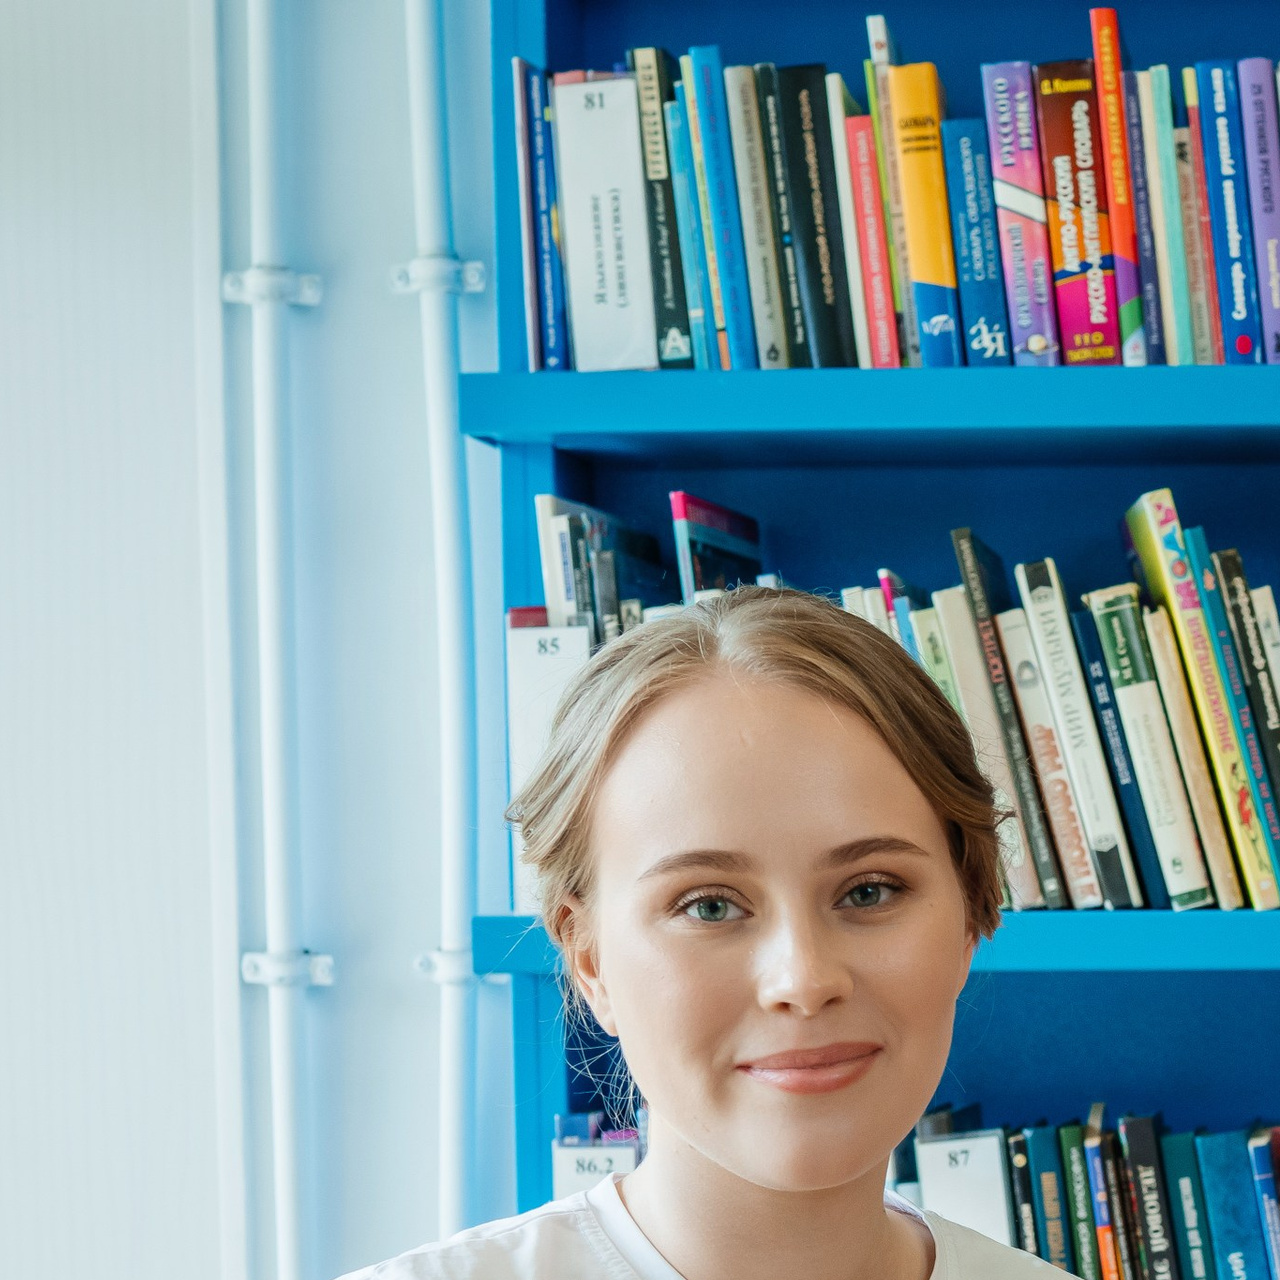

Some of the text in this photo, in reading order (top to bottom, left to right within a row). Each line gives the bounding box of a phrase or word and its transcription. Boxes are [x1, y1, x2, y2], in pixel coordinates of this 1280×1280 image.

[583, 92, 606, 110] 81
[991, 77, 1016, 165] РУССКОГО
[1070, 99, 1094, 169] СЛОВАРЬ
[537, 637, 560, 657] 85
[1038, 607, 1088, 749] МИР МУЗЫКИ
[1182, 614, 1239, 754] ЭНЦИКЛОПЕДИЯ
[1029, 719, 1063, 775] МИР
[1045, 775, 1091, 880] ПОЗНАЮ
[576, 1157, 614, 1175] 86.2
[947, 1148, 970, 1169] 87
[1137, 1163, 1170, 1254] ДЕЛОВОЙ
